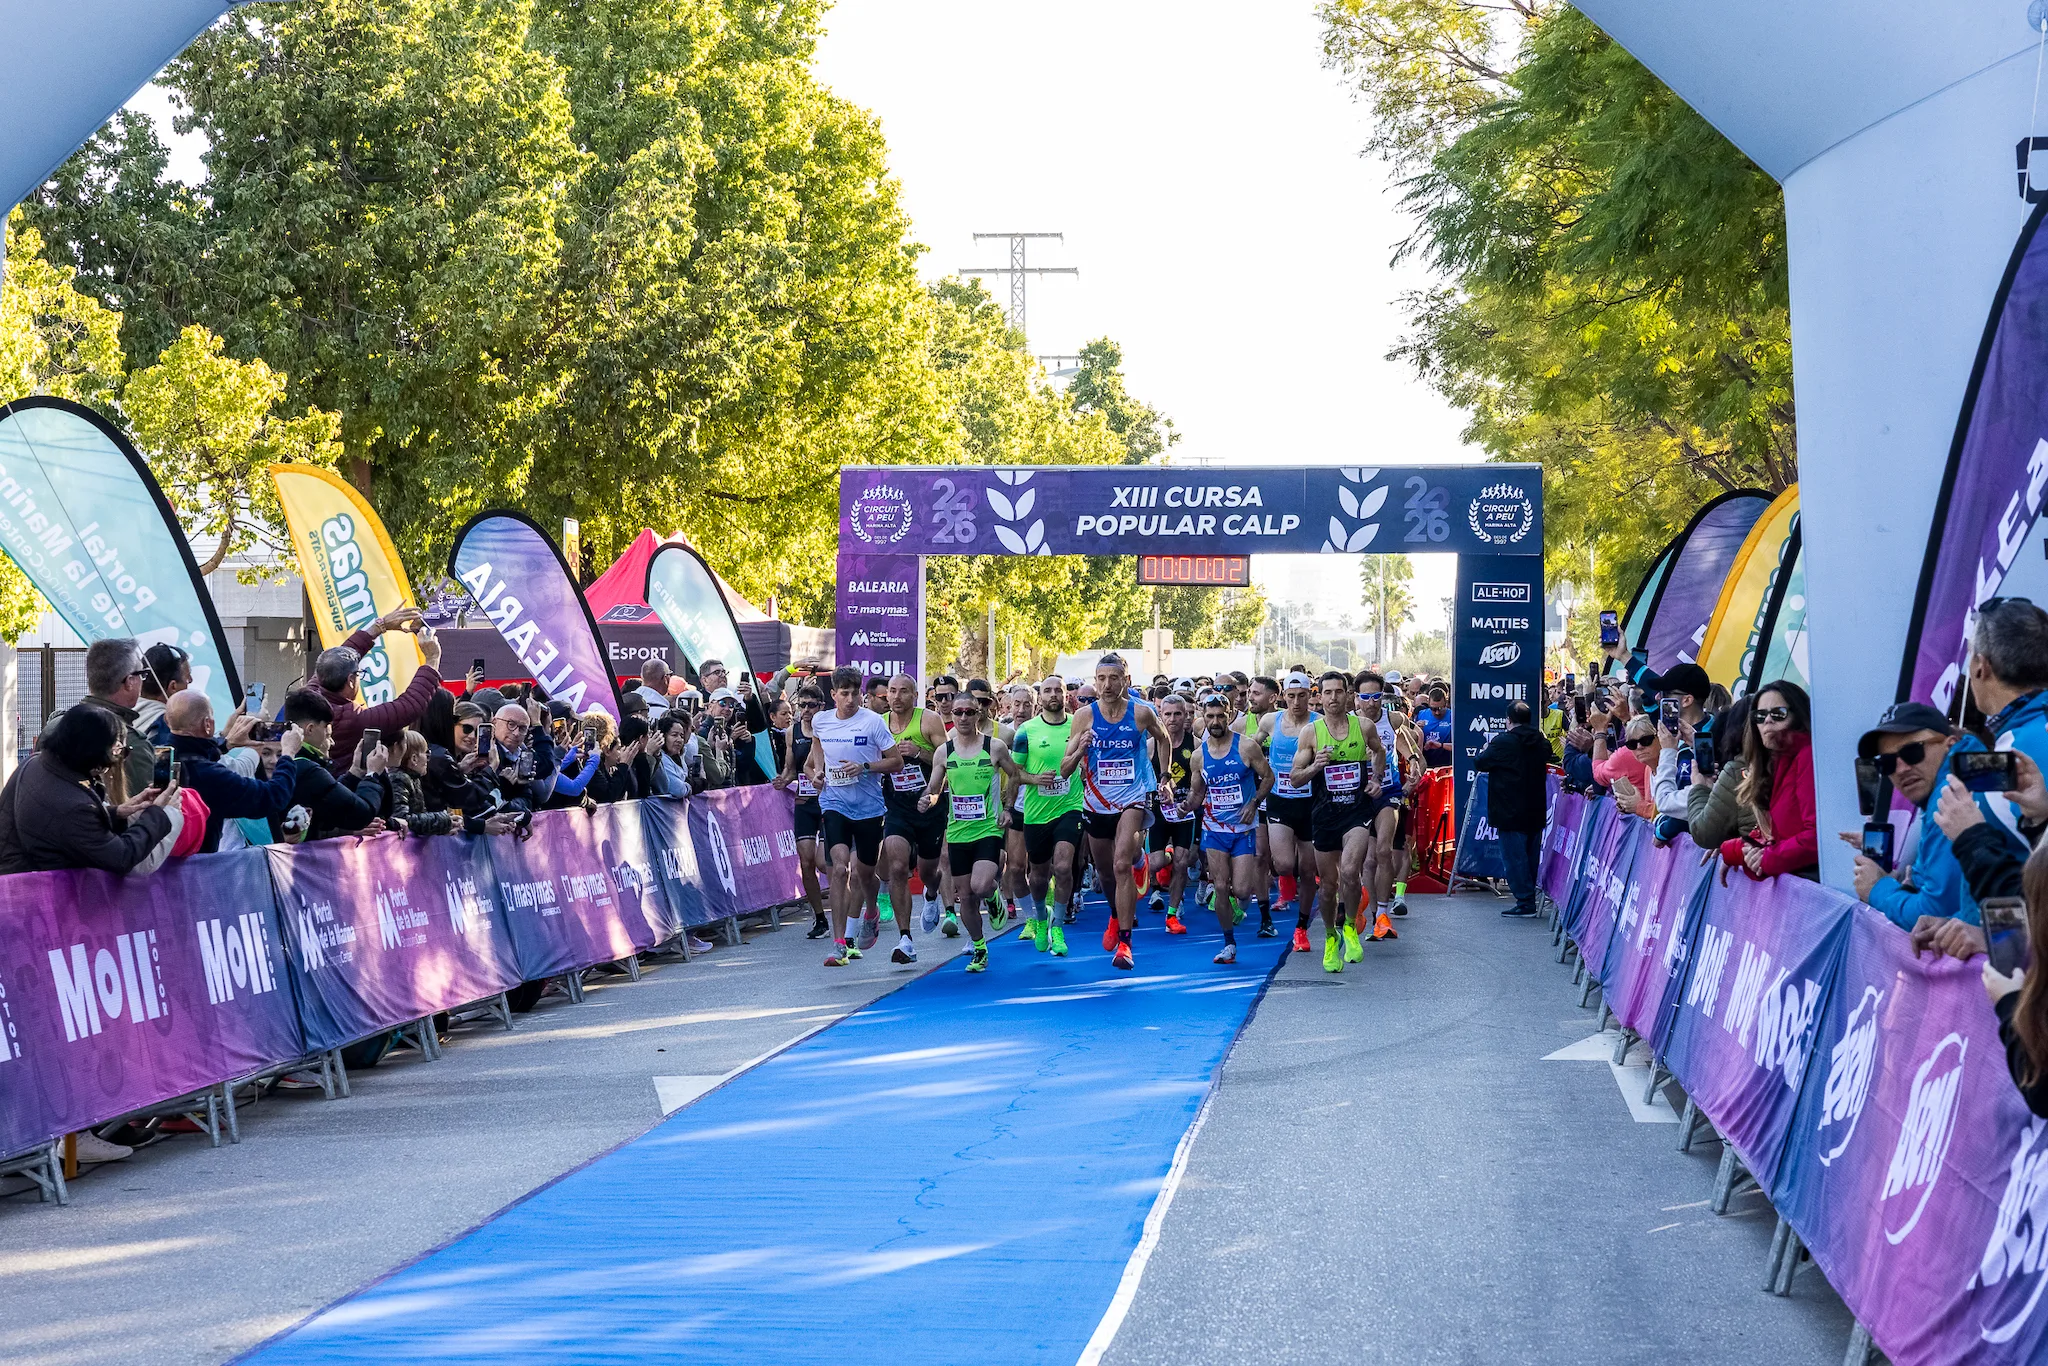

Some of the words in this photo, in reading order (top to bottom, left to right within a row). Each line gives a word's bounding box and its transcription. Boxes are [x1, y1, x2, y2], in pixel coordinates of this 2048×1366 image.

[1110, 486, 1159, 507] XIII
[1164, 486, 1263, 507] CURSA
[1482, 504, 1520, 512] CIRCUIT
[864, 505, 900, 513] CIRCUIT
[867, 513, 875, 521] A
[876, 513, 895, 521] PEU
[1486, 512, 1494, 521] A
[1496, 512, 1514, 521] PEU
[1076, 514, 1217, 536] POPULAR
[1222, 514, 1301, 536] CALP
[1144, 556, 1243, 582] 00:00:02
[1477, 587, 1526, 598] ALE-HOP
[860, 606, 908, 615] masymas
[1471, 617, 1530, 629] MATTIES
[388, 886, 409, 908] Portal
[513, 879, 556, 912] masymas
[571, 871, 608, 903] masymas
[313, 899, 335, 924] Portal
[395, 911, 406, 931] de
[405, 909, 411, 929] la
[410, 907, 430, 928] Marina
[318, 930, 330, 949] de
[329, 927, 337, 946] la
[335, 924, 357, 946] Marina
[258, 911, 278, 991] MOTOR
[148, 929, 169, 1017] MOTOR
[47, 930, 161, 1043] Moll
[0, 972, 22, 1059] OTOR
